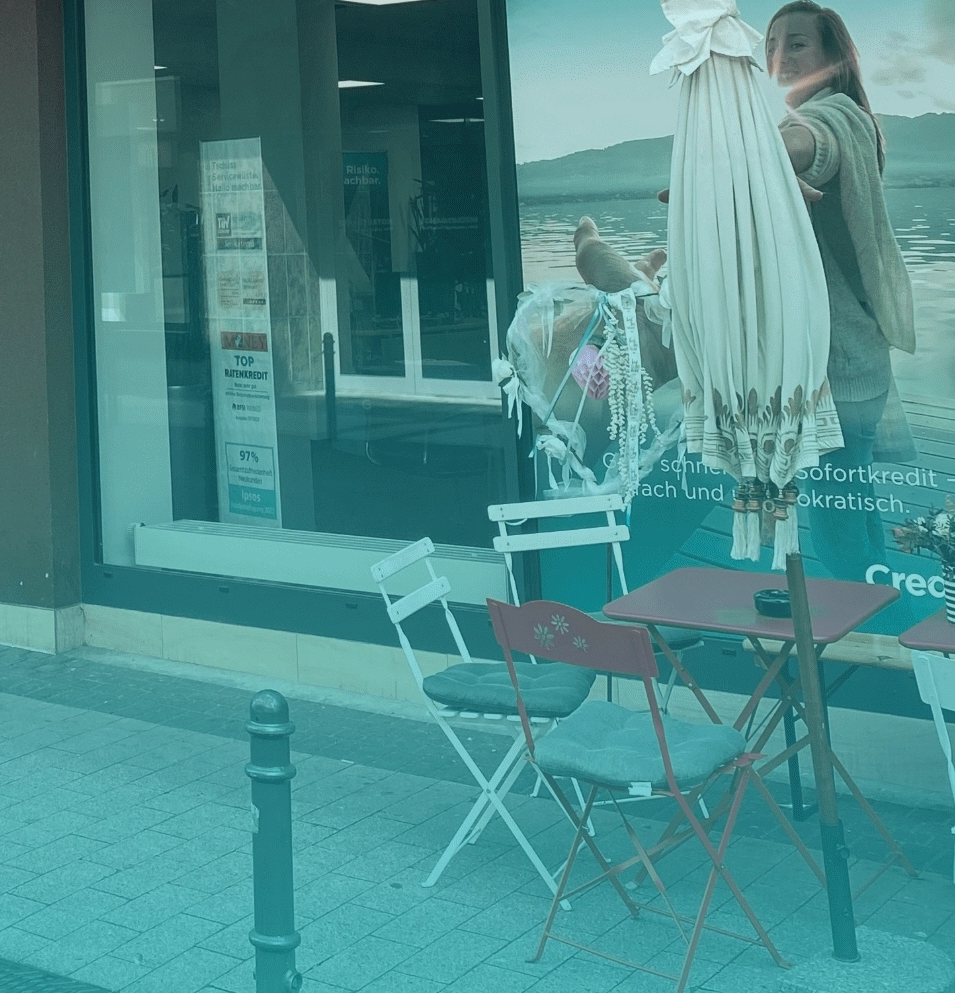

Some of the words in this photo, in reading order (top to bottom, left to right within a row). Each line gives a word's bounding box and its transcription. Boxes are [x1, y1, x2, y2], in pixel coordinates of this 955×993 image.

[346, 164, 380, 175] Risiko.
[343, 175, 382, 185] achbar.
[234, 355, 255, 367] TOP
[224, 369, 268, 381] RATENKREDIT
[239, 450, 259, 463] 97%
[795, 462, 938, 488] Sofortkredit
[685, 483, 724, 502] und
[733, 488, 910, 514] okratisch.
